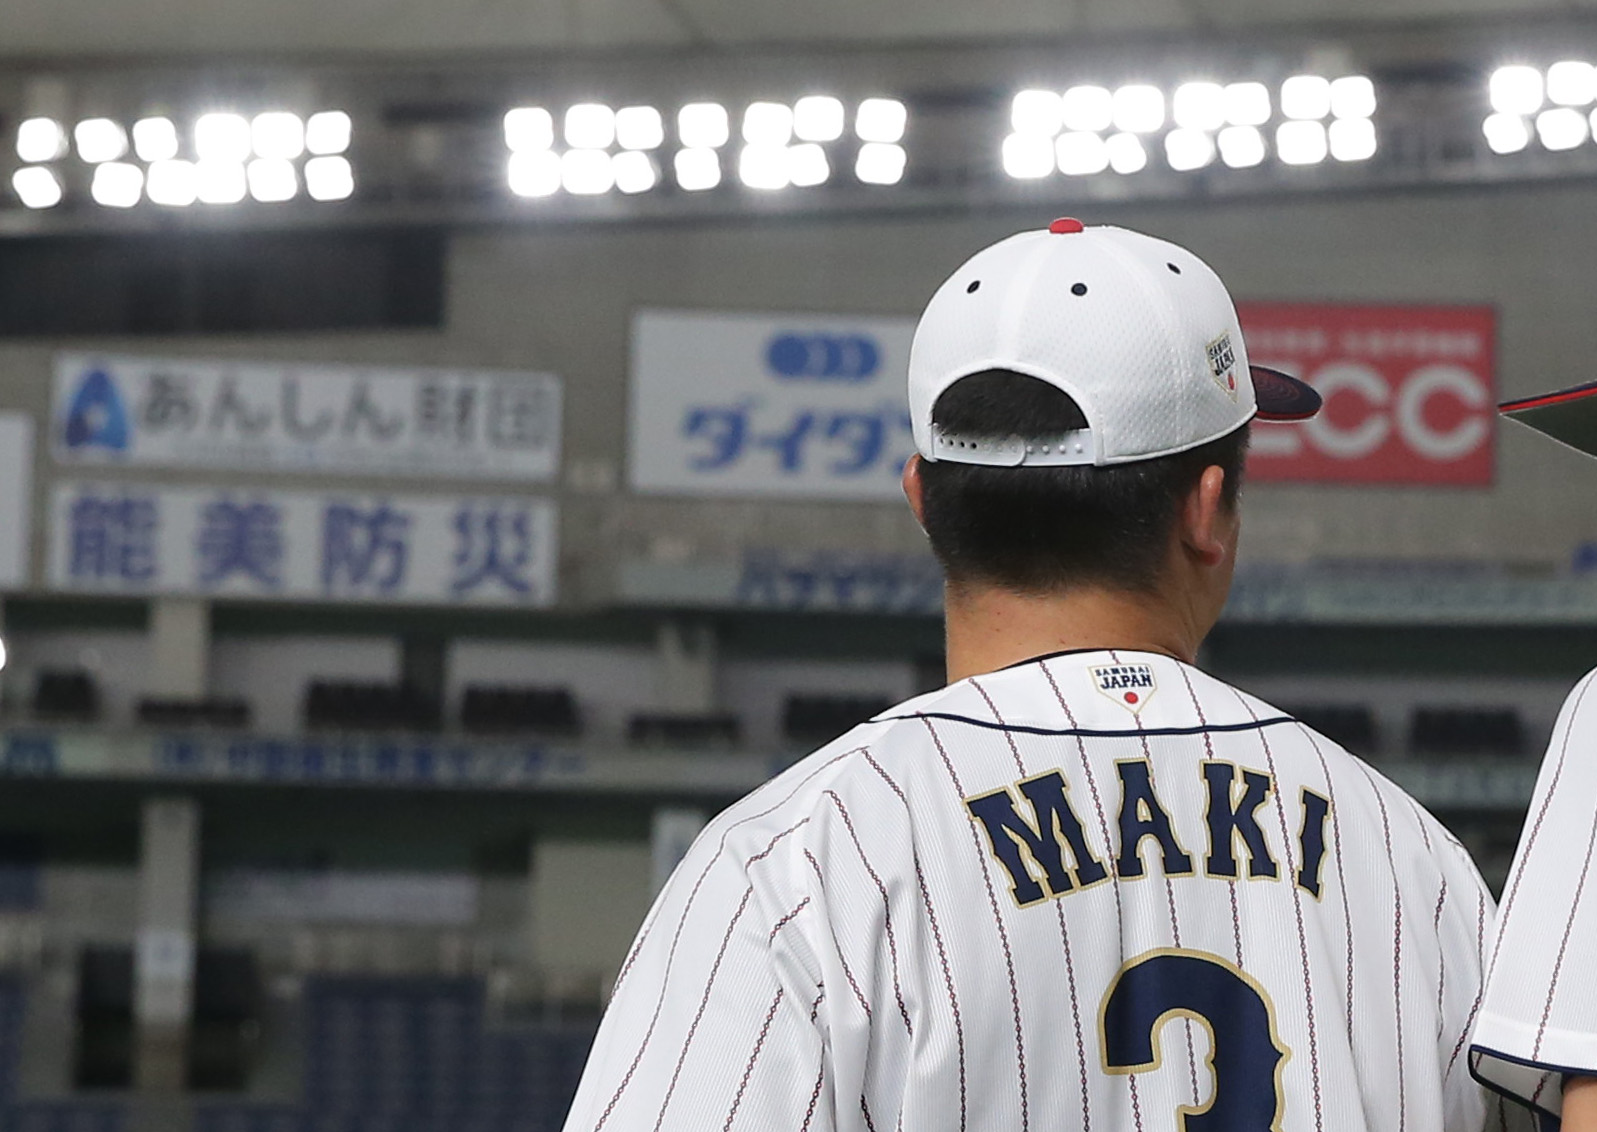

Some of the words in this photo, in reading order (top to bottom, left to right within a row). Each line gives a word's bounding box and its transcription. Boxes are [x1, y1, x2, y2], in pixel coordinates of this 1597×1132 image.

[142, 374, 549, 447] あんしん財団
[682, 394, 911, 476] ダイダ
[70, 494, 532, 593] 能美防災
[1095, 666, 1149, 677] SAMURAI
[1100, 674, 1153, 689] JAPAN
[964, 758, 1332, 909] MAKI
